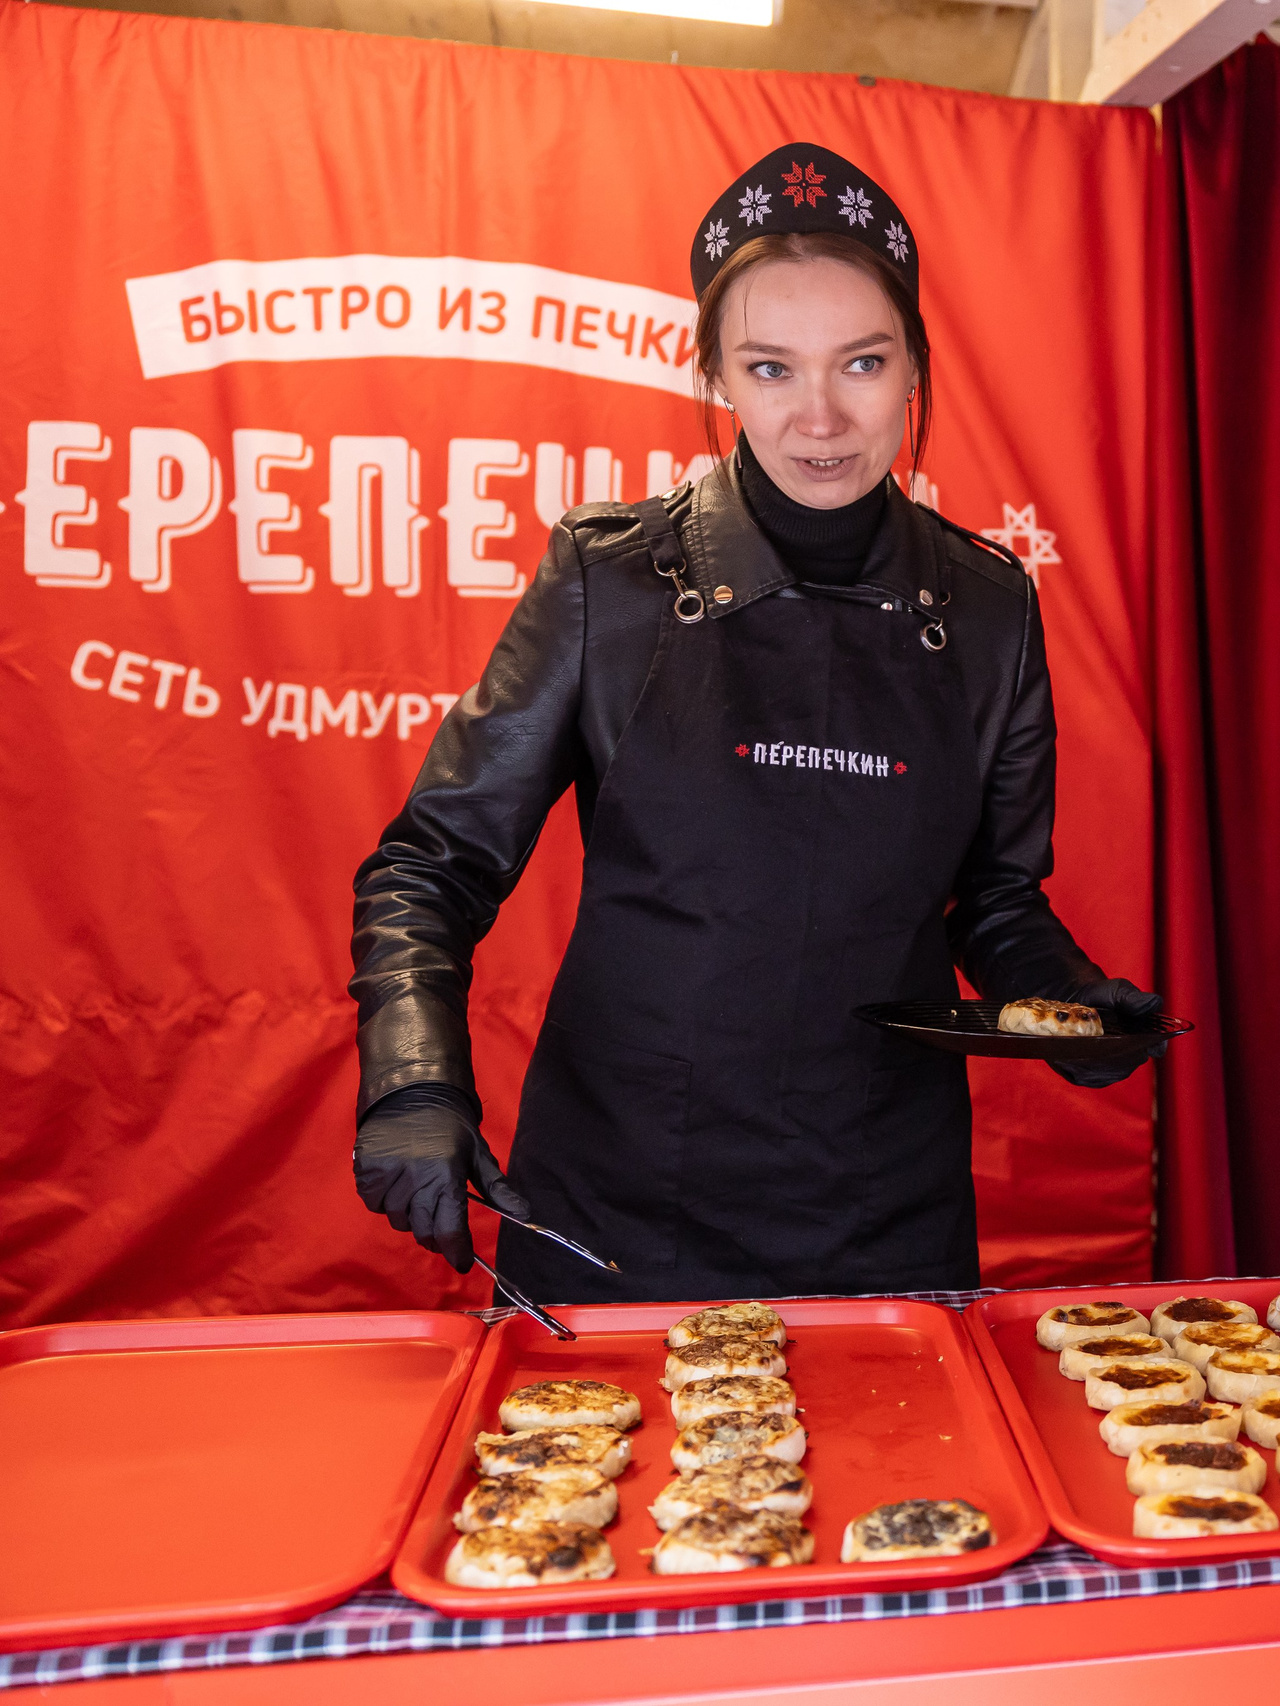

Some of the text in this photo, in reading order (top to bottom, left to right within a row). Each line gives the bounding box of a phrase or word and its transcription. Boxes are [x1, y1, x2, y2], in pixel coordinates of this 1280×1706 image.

[179, 284, 412, 344] БЫСТРО
[438, 286, 507, 333] ИЗ
[0, 419, 939, 598] ЕРЕПЕЧ
[70, 640, 221, 719] СЕТЬ
